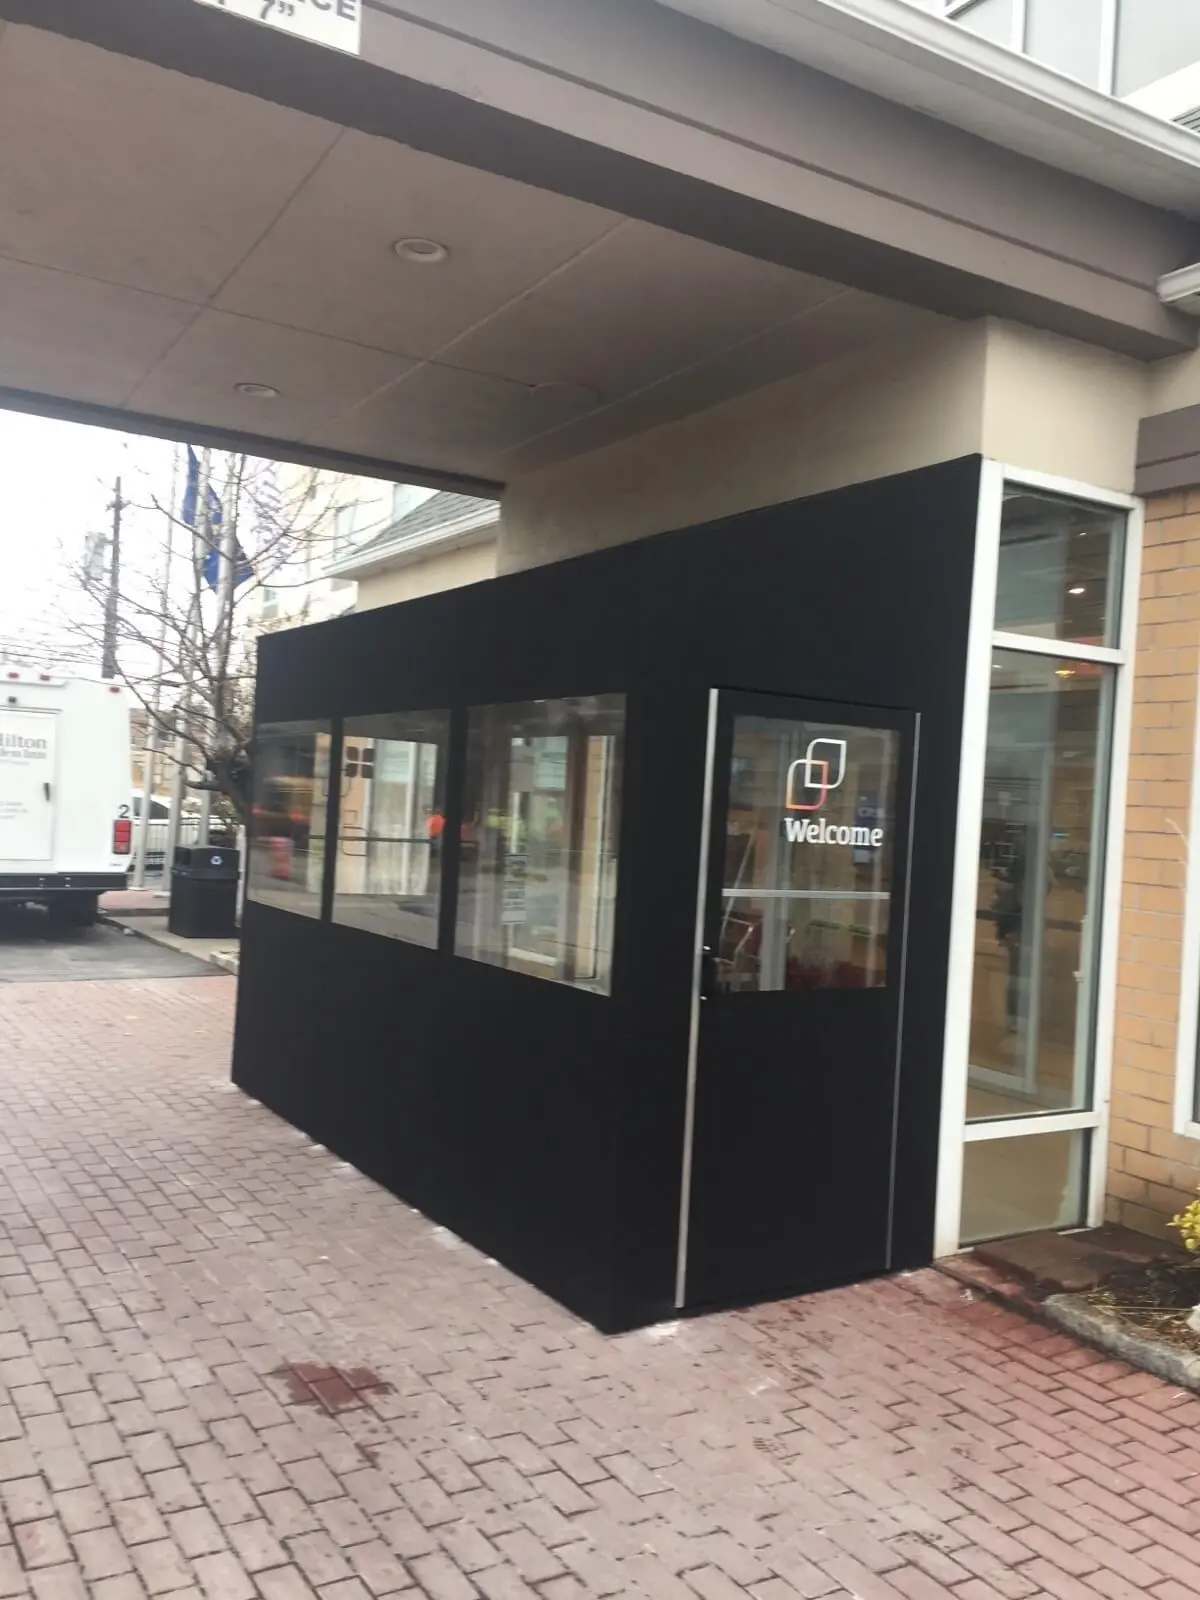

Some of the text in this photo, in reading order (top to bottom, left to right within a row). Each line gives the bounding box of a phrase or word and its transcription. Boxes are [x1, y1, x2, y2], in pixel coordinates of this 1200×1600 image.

[0, 733, 47, 749] ilton
[118, 804, 130, 818] 2
[783, 817, 884, 847] Welcome
